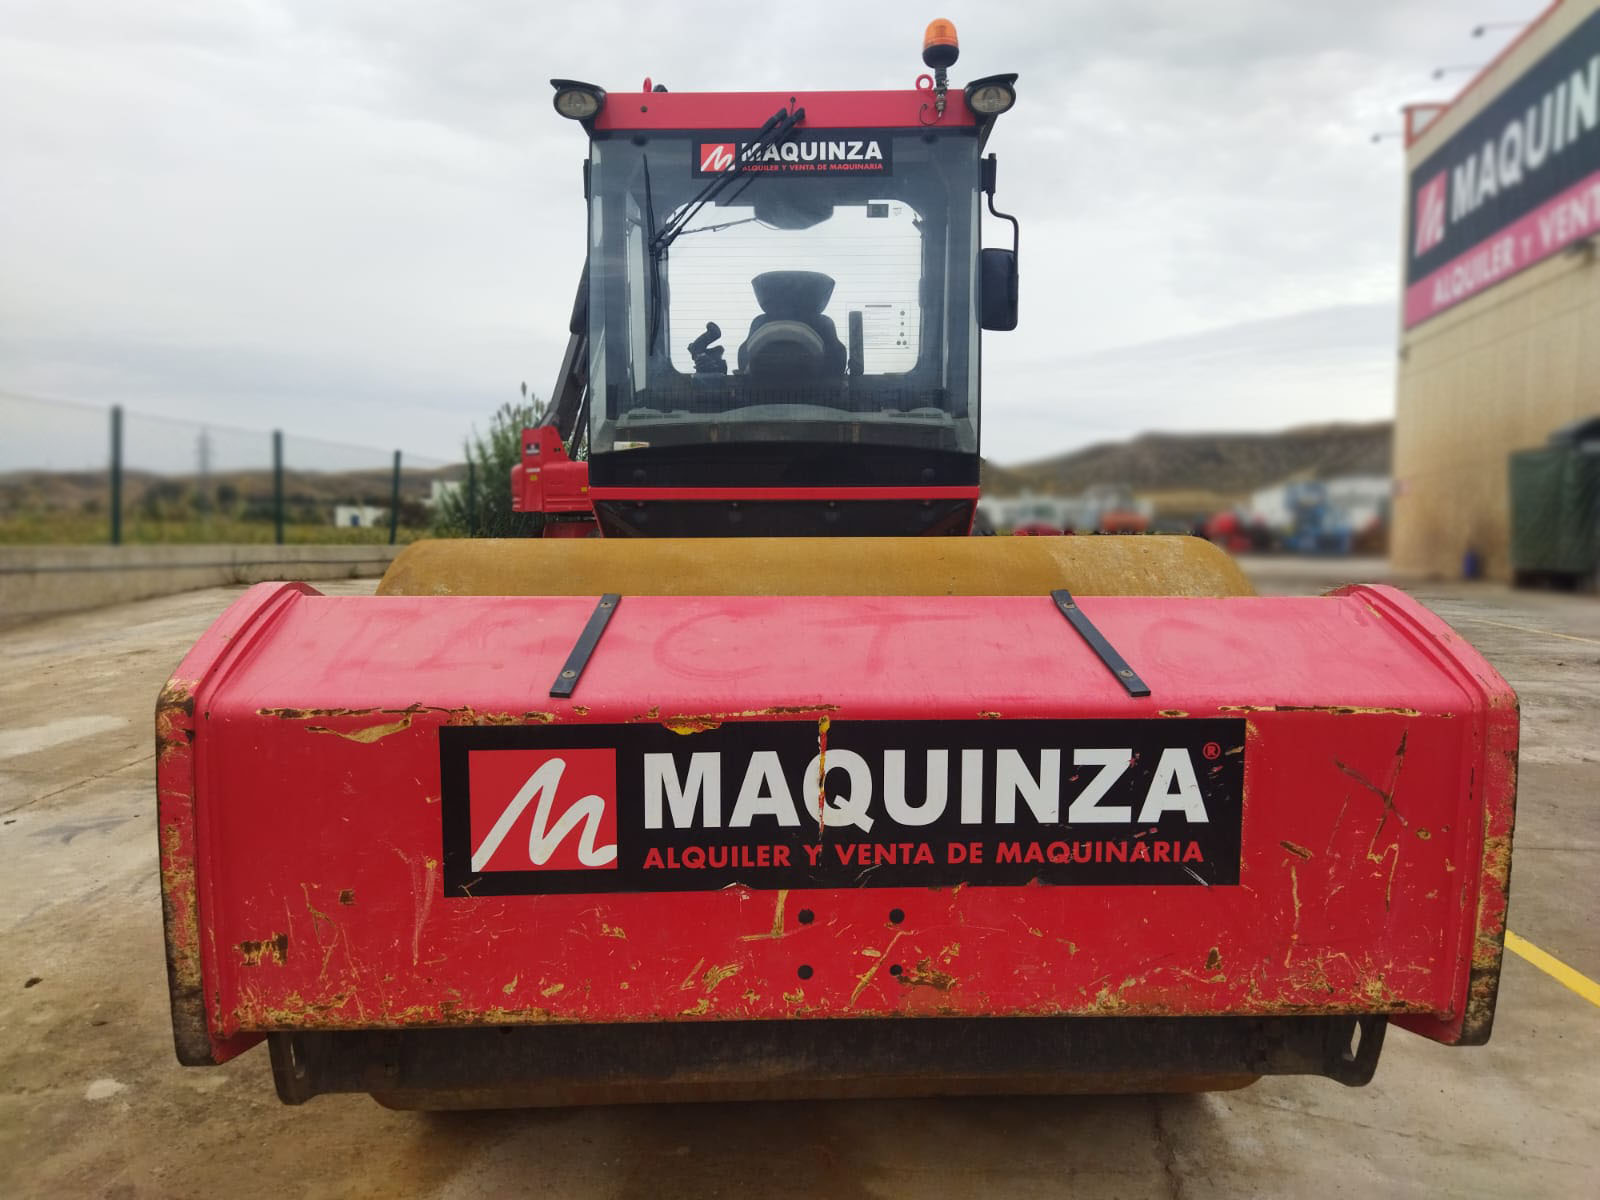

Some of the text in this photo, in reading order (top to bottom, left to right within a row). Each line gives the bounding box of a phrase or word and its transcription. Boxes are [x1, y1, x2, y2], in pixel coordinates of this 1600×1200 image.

[741, 141, 883, 162] MAQUINZA
[829, 163, 883, 171] MAQUINARIA
[1431, 236, 1515, 305] ALQUILER
[643, 747, 1209, 834] MAQUINZA
[643, 841, 1204, 869] ALQUILER Y VENTA DE MAQUINARIA
